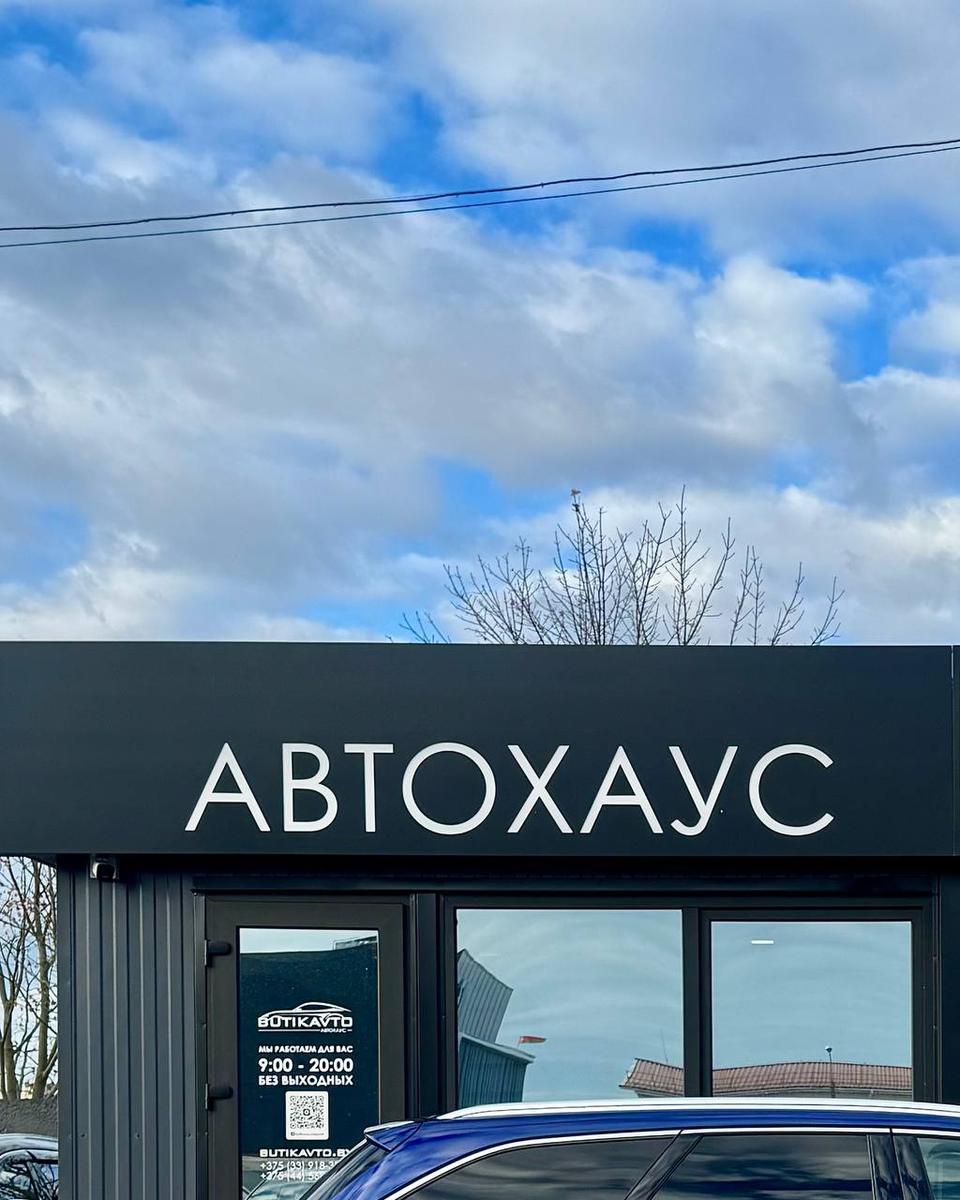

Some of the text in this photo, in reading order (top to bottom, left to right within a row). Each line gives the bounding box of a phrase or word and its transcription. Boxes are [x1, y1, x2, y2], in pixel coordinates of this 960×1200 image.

[185, 742, 834, 836] АВТОХАУС
[257, 1016, 353, 1028] BUTIKAVTO
[258, 1045, 353, 1054] МЫ РАБОТАЕМ ДЛЯ ВАС
[258, 1058, 293, 1073] 9:00
[309, 1058, 353, 1073] 20:00
[258, 1075, 353, 1087] БЕЗ ВЫХОДНЫХ
[260, 1161, 284, 1171] +375
[287, 1161, 305, 1172] (33)
